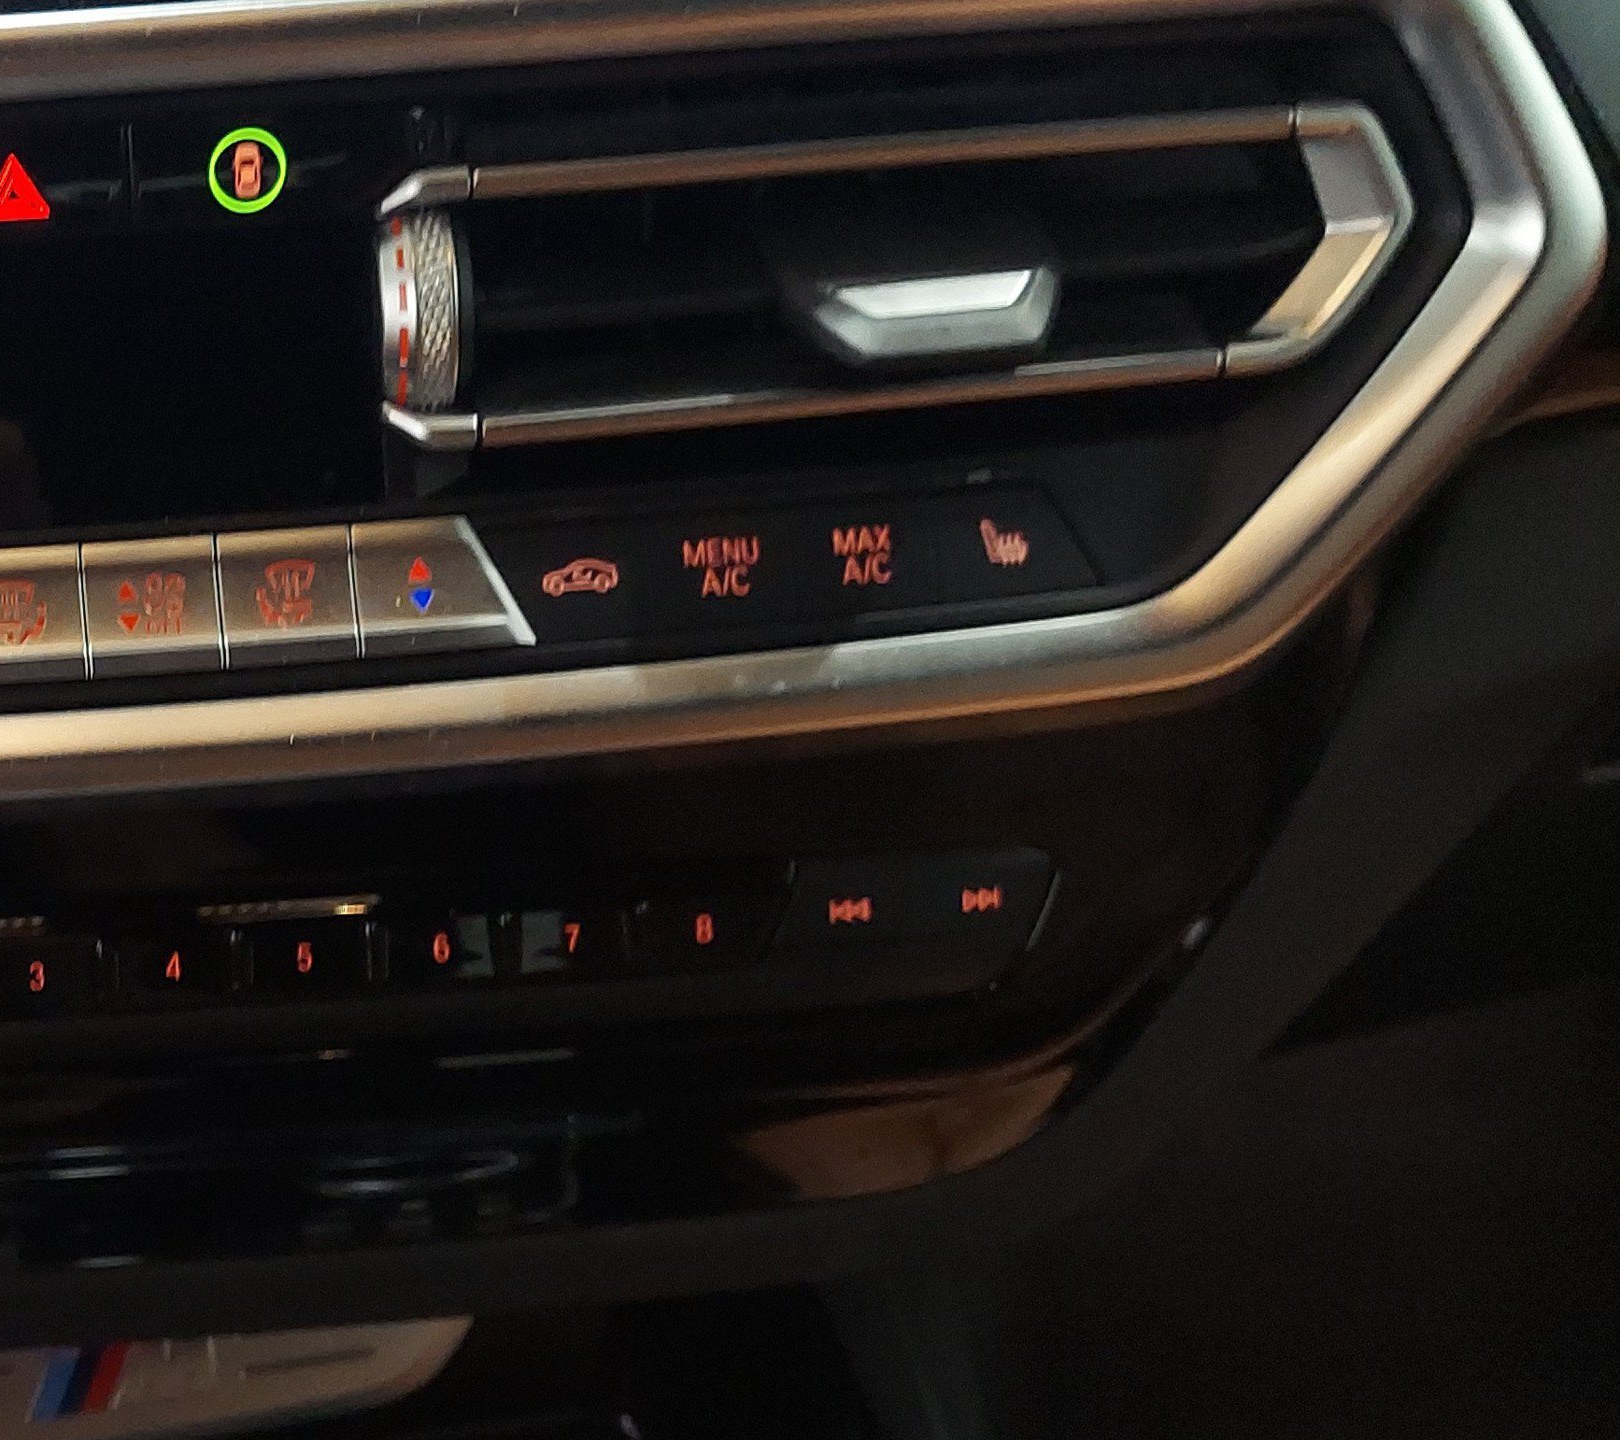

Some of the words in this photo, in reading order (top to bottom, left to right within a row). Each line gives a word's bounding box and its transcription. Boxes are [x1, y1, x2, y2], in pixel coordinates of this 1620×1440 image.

[682, 535, 760, 568] MENU
[832, 524, 890, 557] MAX
[701, 567, 750, 598] A/C
[842, 554, 892, 586] A/C
[29, 960, 45, 991] 3
[165, 950, 181, 982] 4
[297, 941, 312, 973] 5
[433, 932, 450, 964] 6
[565, 922, 581, 953] 7
[695, 913, 713, 944] 8
